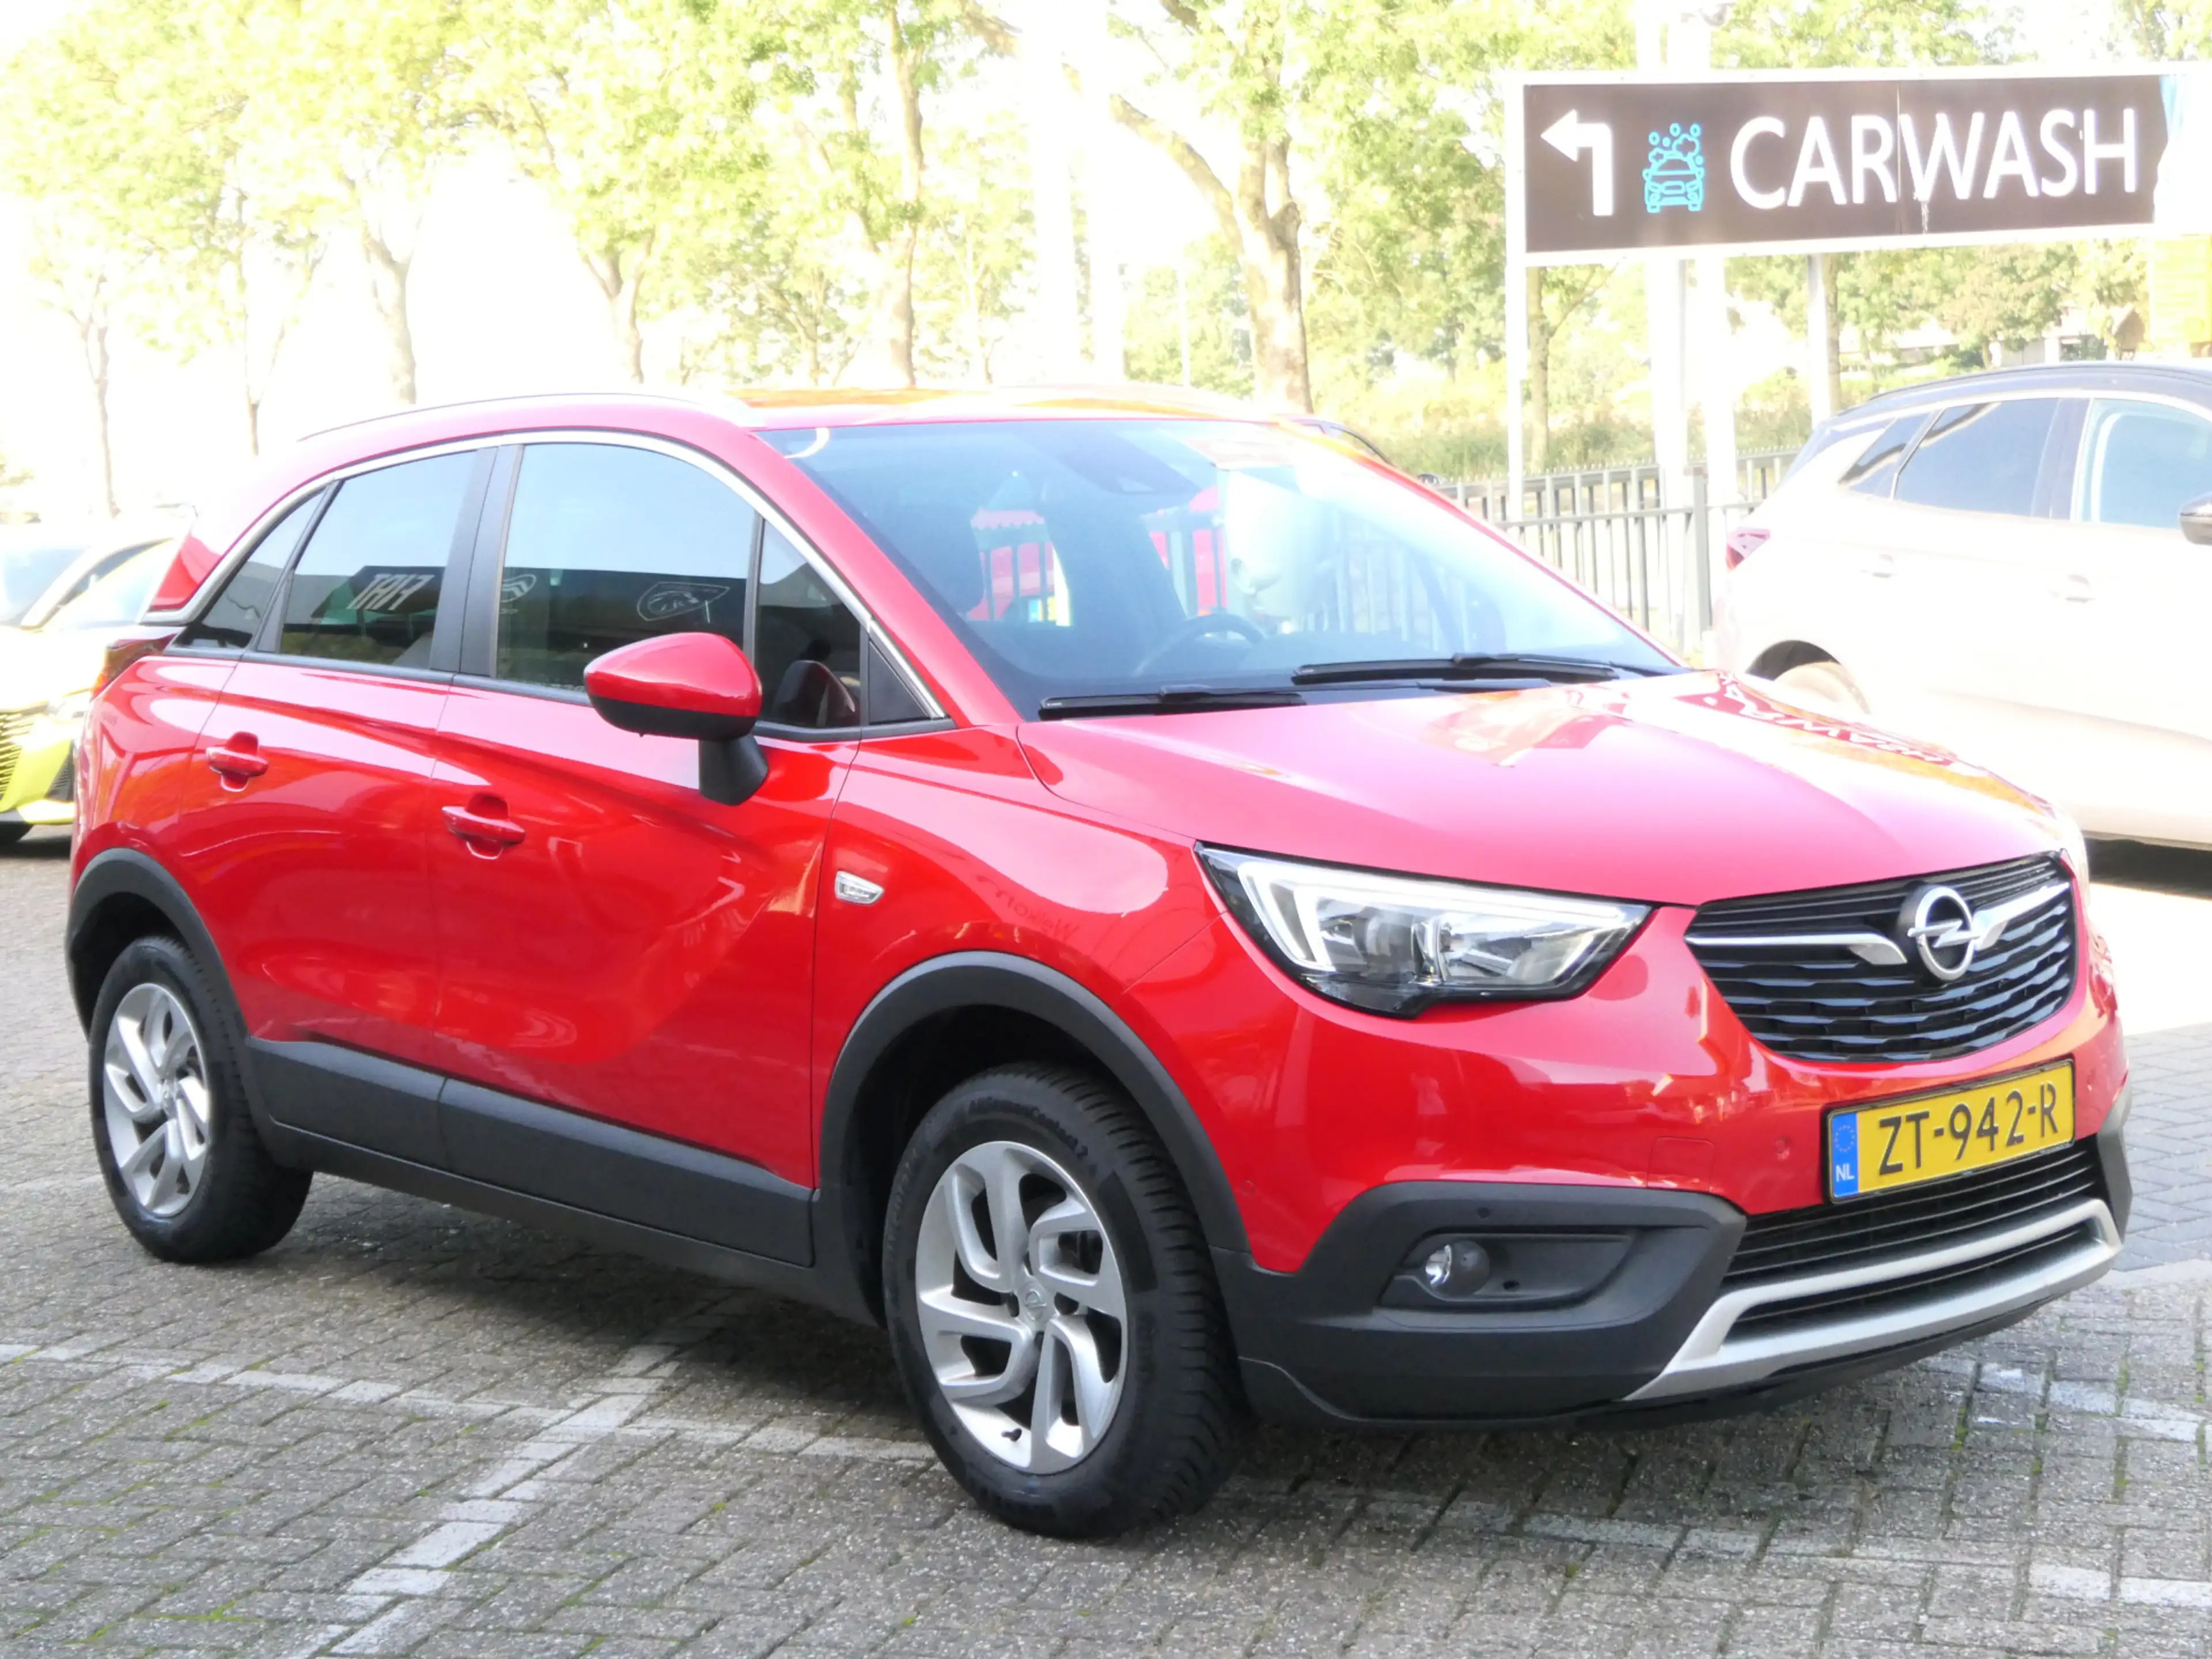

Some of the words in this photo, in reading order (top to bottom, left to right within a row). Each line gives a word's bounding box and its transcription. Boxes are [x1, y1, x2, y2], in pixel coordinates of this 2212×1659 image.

[1730, 108, 2138, 210] CARWASH
[1835, 1164, 1855, 1181] NL
[1878, 1081, 2059, 1176] ZT-942-R
